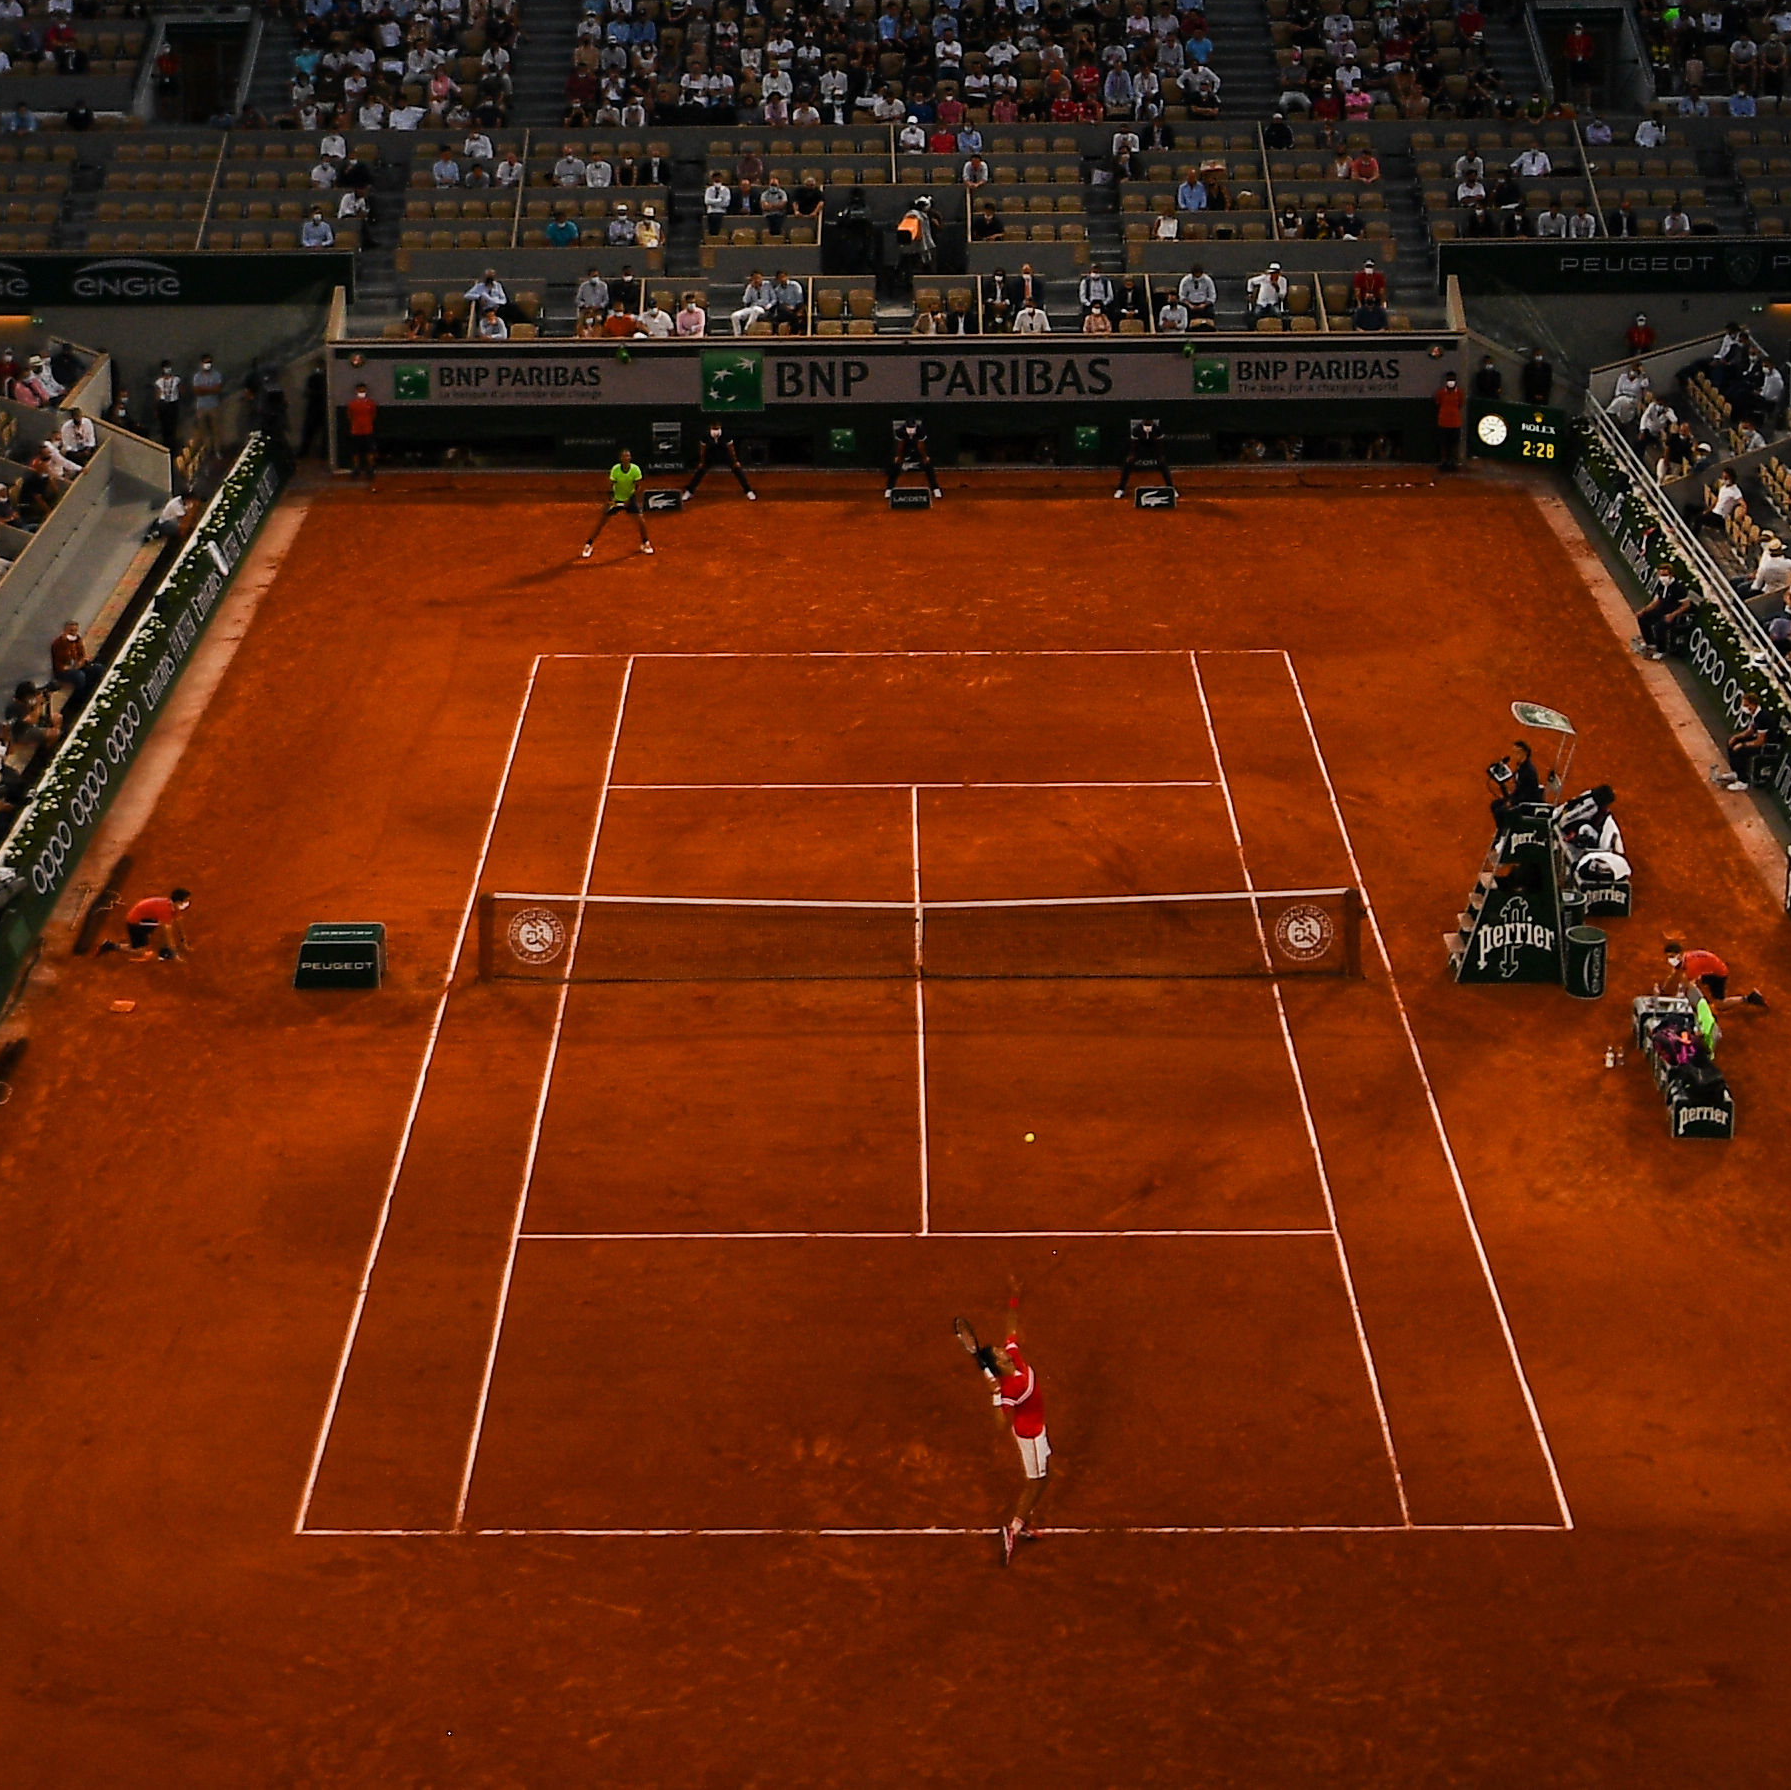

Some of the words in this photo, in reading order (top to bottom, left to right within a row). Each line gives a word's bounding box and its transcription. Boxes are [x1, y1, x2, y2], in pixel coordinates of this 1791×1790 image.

[1560, 256, 1714, 272] PEUGEOT
[439, 366, 489, 387] BNP
[497, 365, 601, 387] PARIBAS
[776, 360, 870, 397] BNP
[920, 358, 1113, 397] PARIBAS
[1237, 360, 1288, 381] BNP
[1296, 359, 1400, 380] PARIBAS
[1521, 422, 1556, 435] ROLEX
[1522, 440, 1555, 459] 2:28
[1689, 627, 1726, 686] oppo
[1723, 677, 1753, 730] opp
[106, 700, 141, 764] oppo
[71, 758, 108, 827] oppo
[32, 820, 73, 895] oppo
[1584, 884, 1628, 914] perrier
[1476, 915, 1555, 971] perrier
[301, 961, 374, 970] PEUGEOT
[1678, 1105, 1729, 1136] perrier
